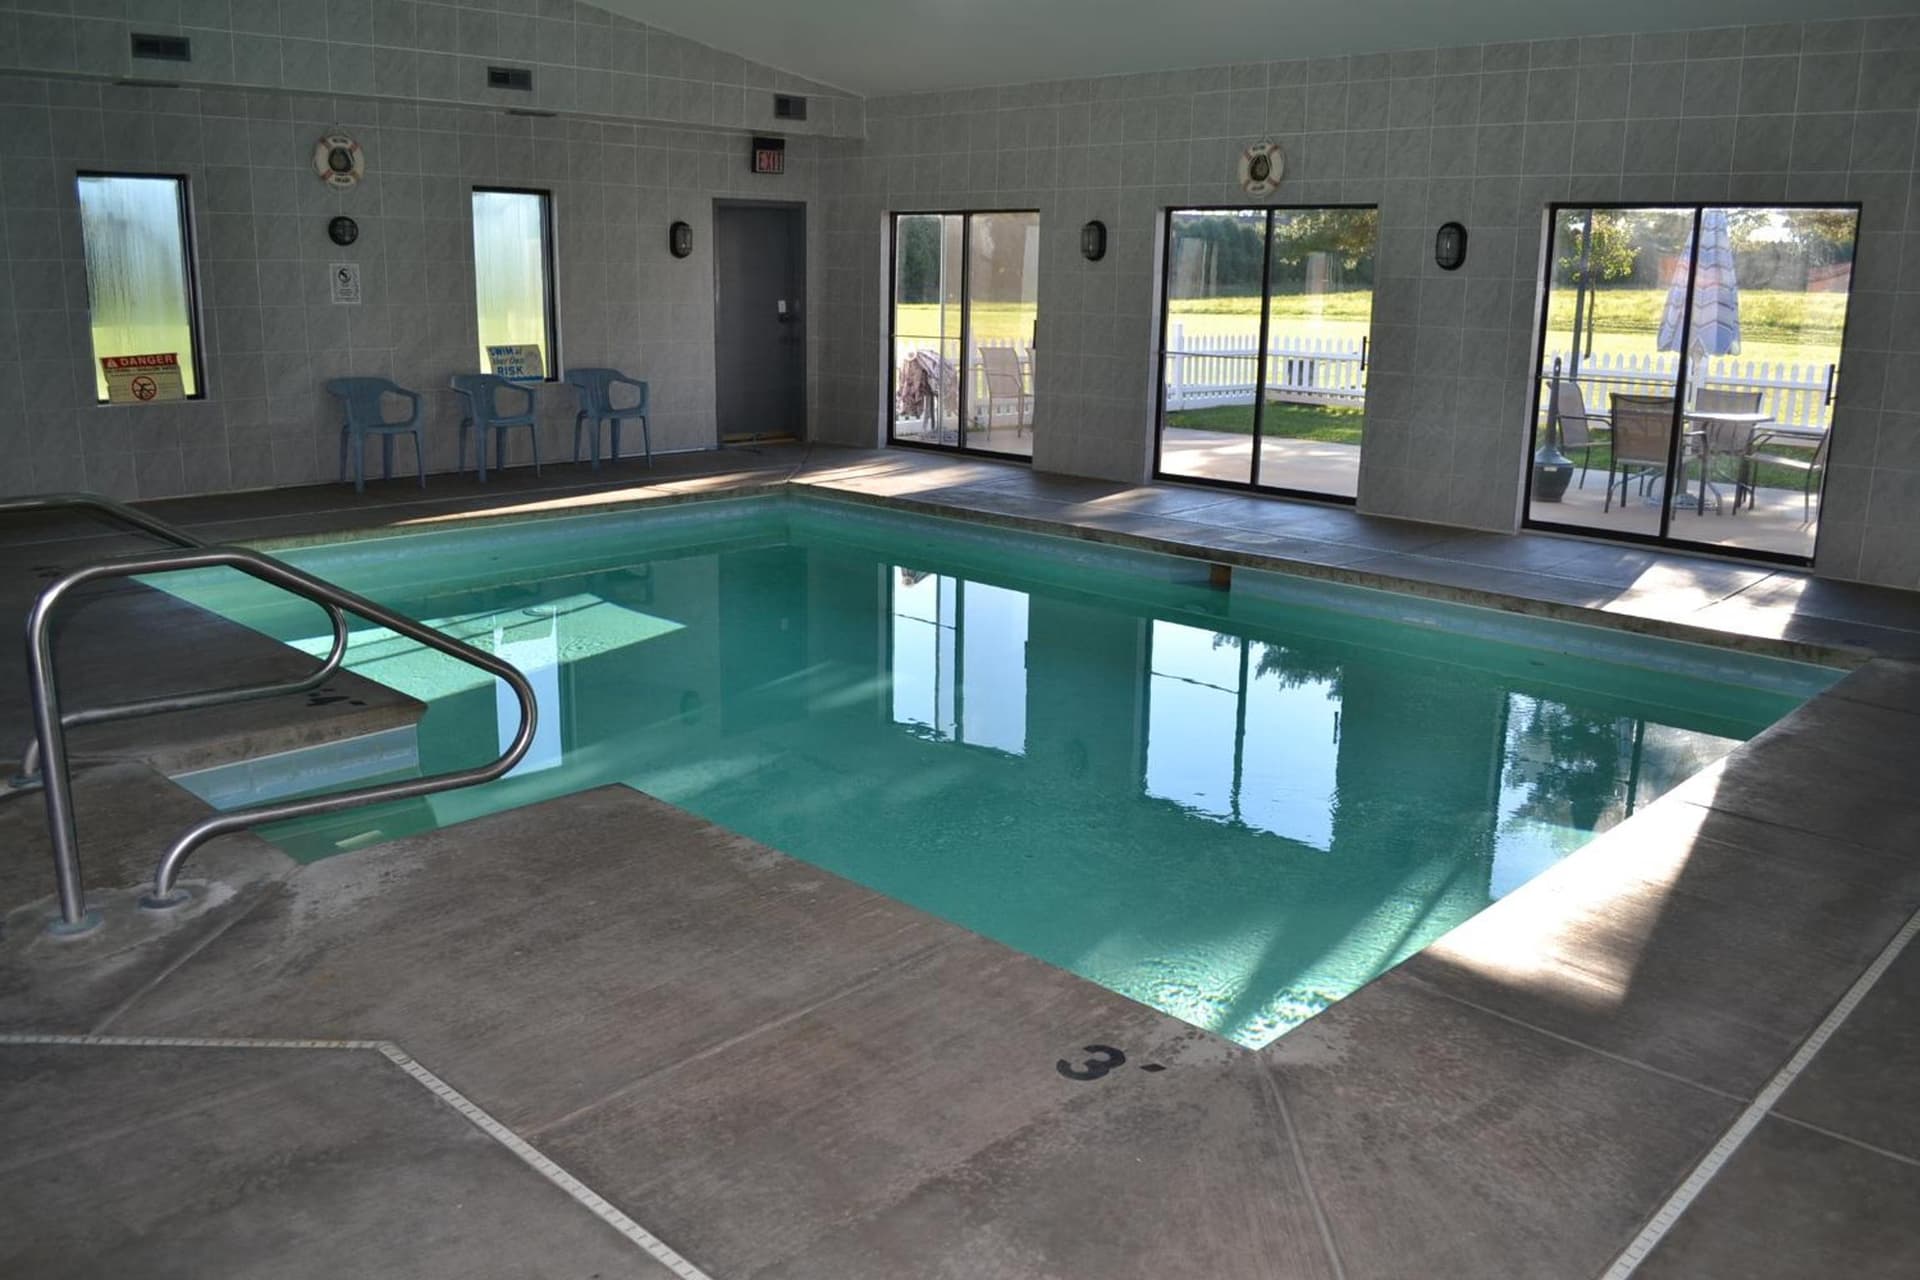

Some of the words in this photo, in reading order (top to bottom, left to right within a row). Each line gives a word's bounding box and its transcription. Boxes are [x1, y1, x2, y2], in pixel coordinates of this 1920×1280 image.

[757, 151, 784, 172] EXIT
[488, 346, 514, 357] SWIM
[120, 354, 174, 367] DANGER
[497, 366, 524, 376] RISK
